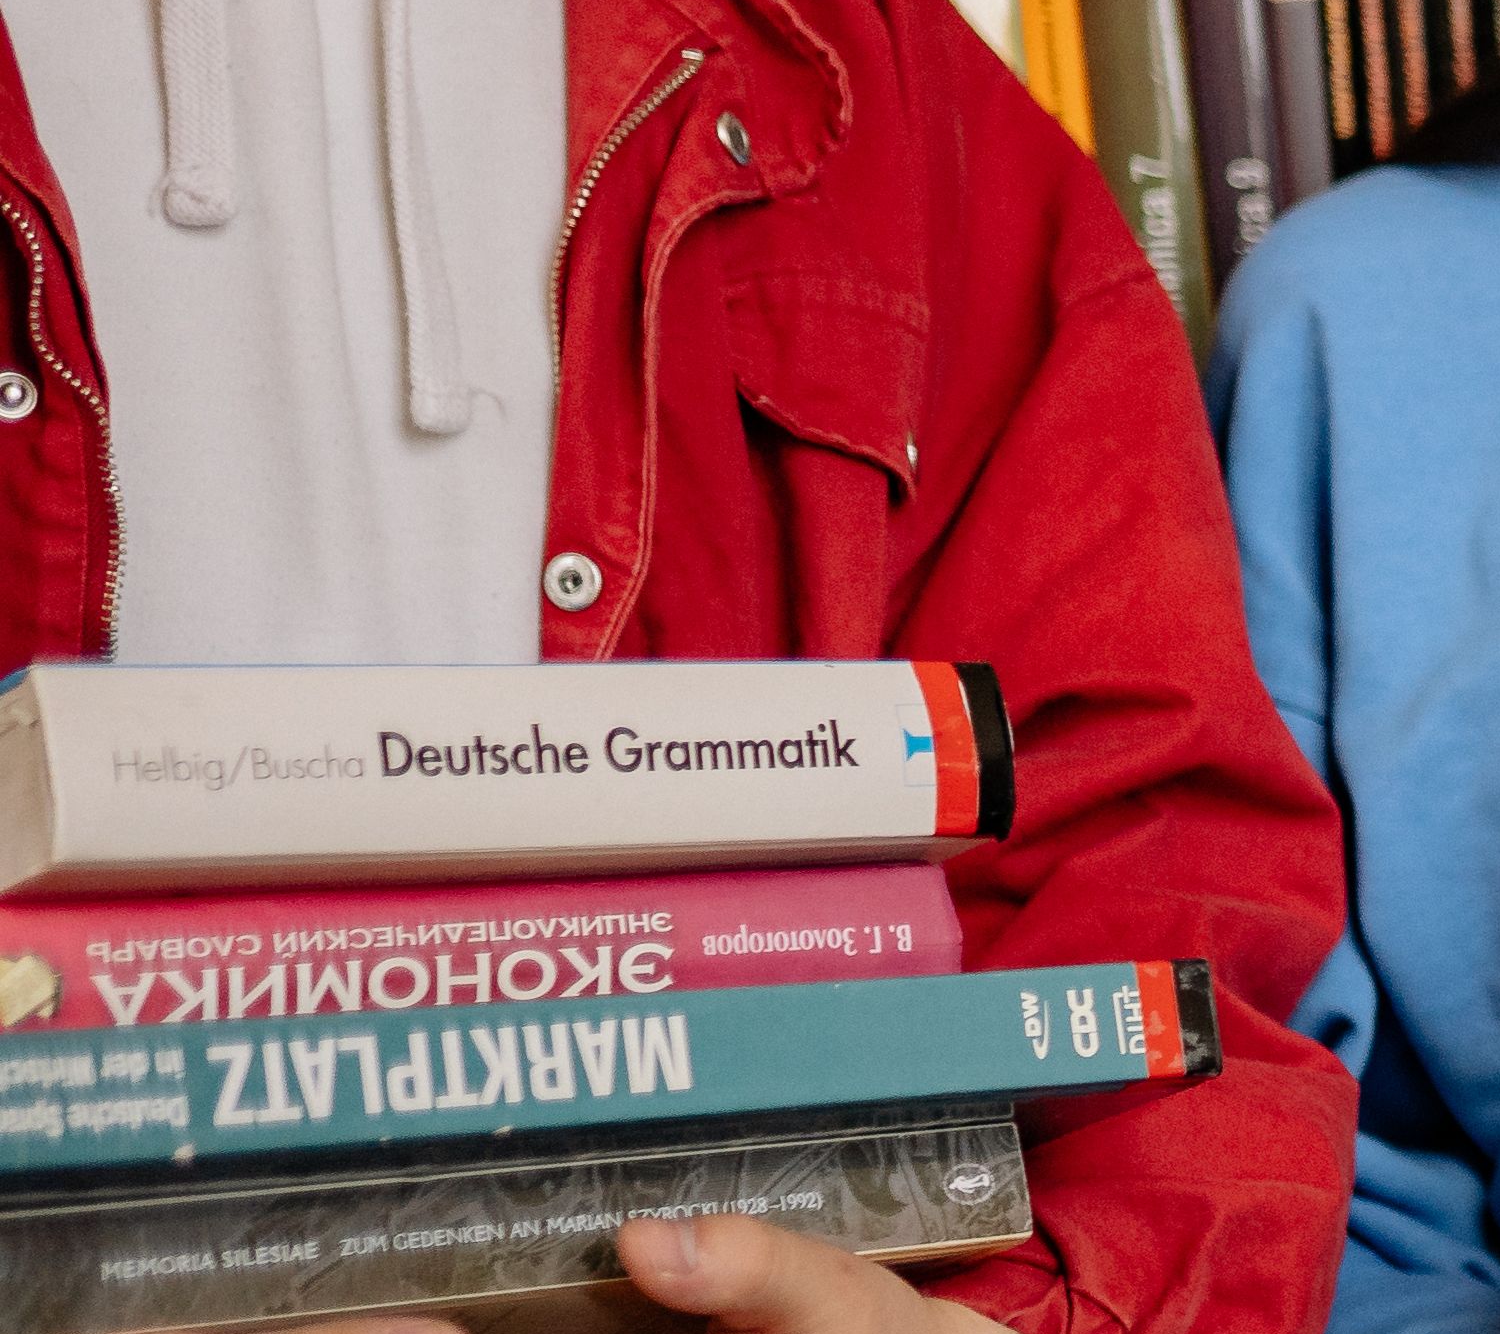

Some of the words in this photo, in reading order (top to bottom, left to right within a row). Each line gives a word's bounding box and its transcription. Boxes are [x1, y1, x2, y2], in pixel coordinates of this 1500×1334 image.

[112, 745, 364, 791] Helbig/Buscha
[377, 724, 589, 777] Deutsche
[604, 720, 859, 773] Grammatik
[86, 935, 261, 963] СЛОВАРЬ
[271, 912, 673, 960] ЭНЦИКЛОПЕДИЧЕСКИЙ
[702, 927, 857, 956] Золотогоров
[863, 927, 881, 954] Г.
[888, 924, 912, 952] В.
[91, 944, 676, 1027] ЭКОНОМИКА
[206, 1014, 693, 1126] MARKTPLATZ
[339, 1236, 388, 1257] ZUM
[394, 1224, 502, 1251] GEDENKEN
[510, 1220, 538, 1239] AN
[548, 1211, 622, 1234] MARIAN
